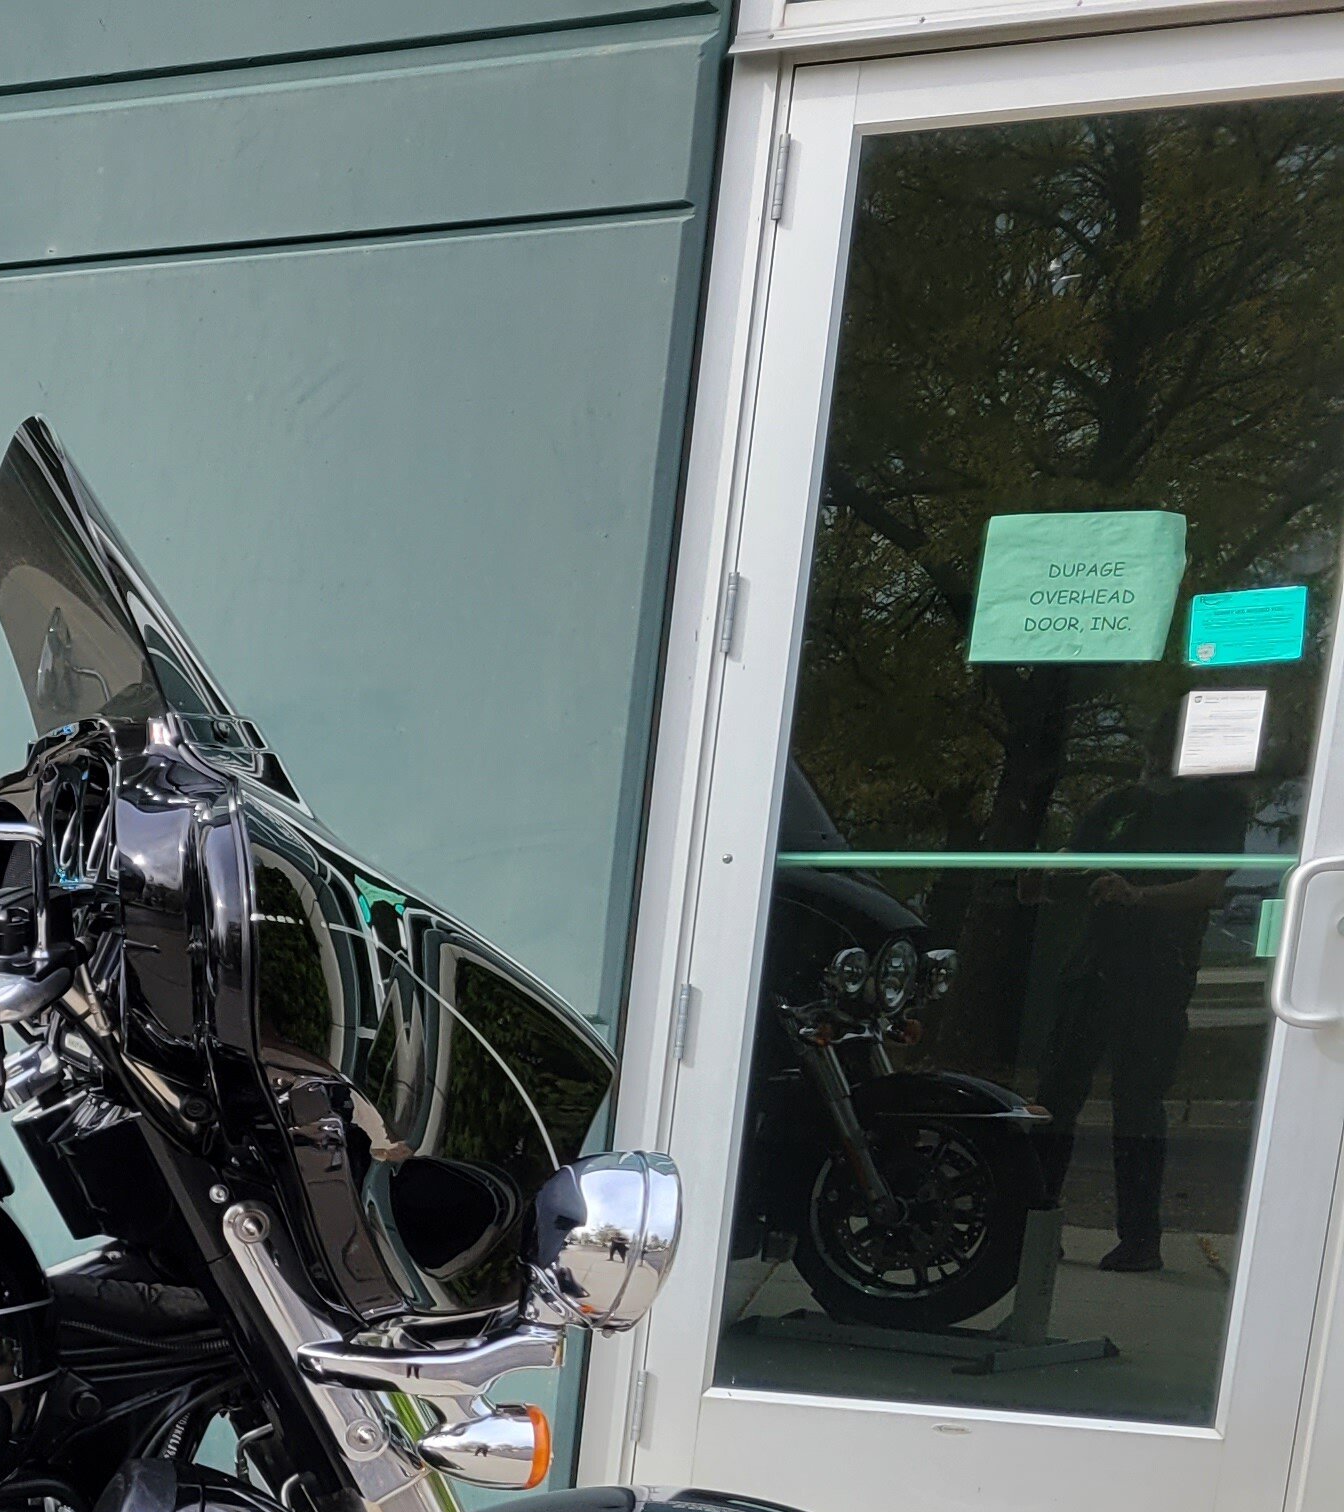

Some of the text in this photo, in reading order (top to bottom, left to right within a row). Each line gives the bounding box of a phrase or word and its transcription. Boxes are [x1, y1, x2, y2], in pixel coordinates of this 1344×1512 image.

[1048, 561, 1127, 579] DUPAGE
[1029, 589, 1135, 606] OVERHEAD
[1023, 615, 1132, 633] DOOR, INC.
